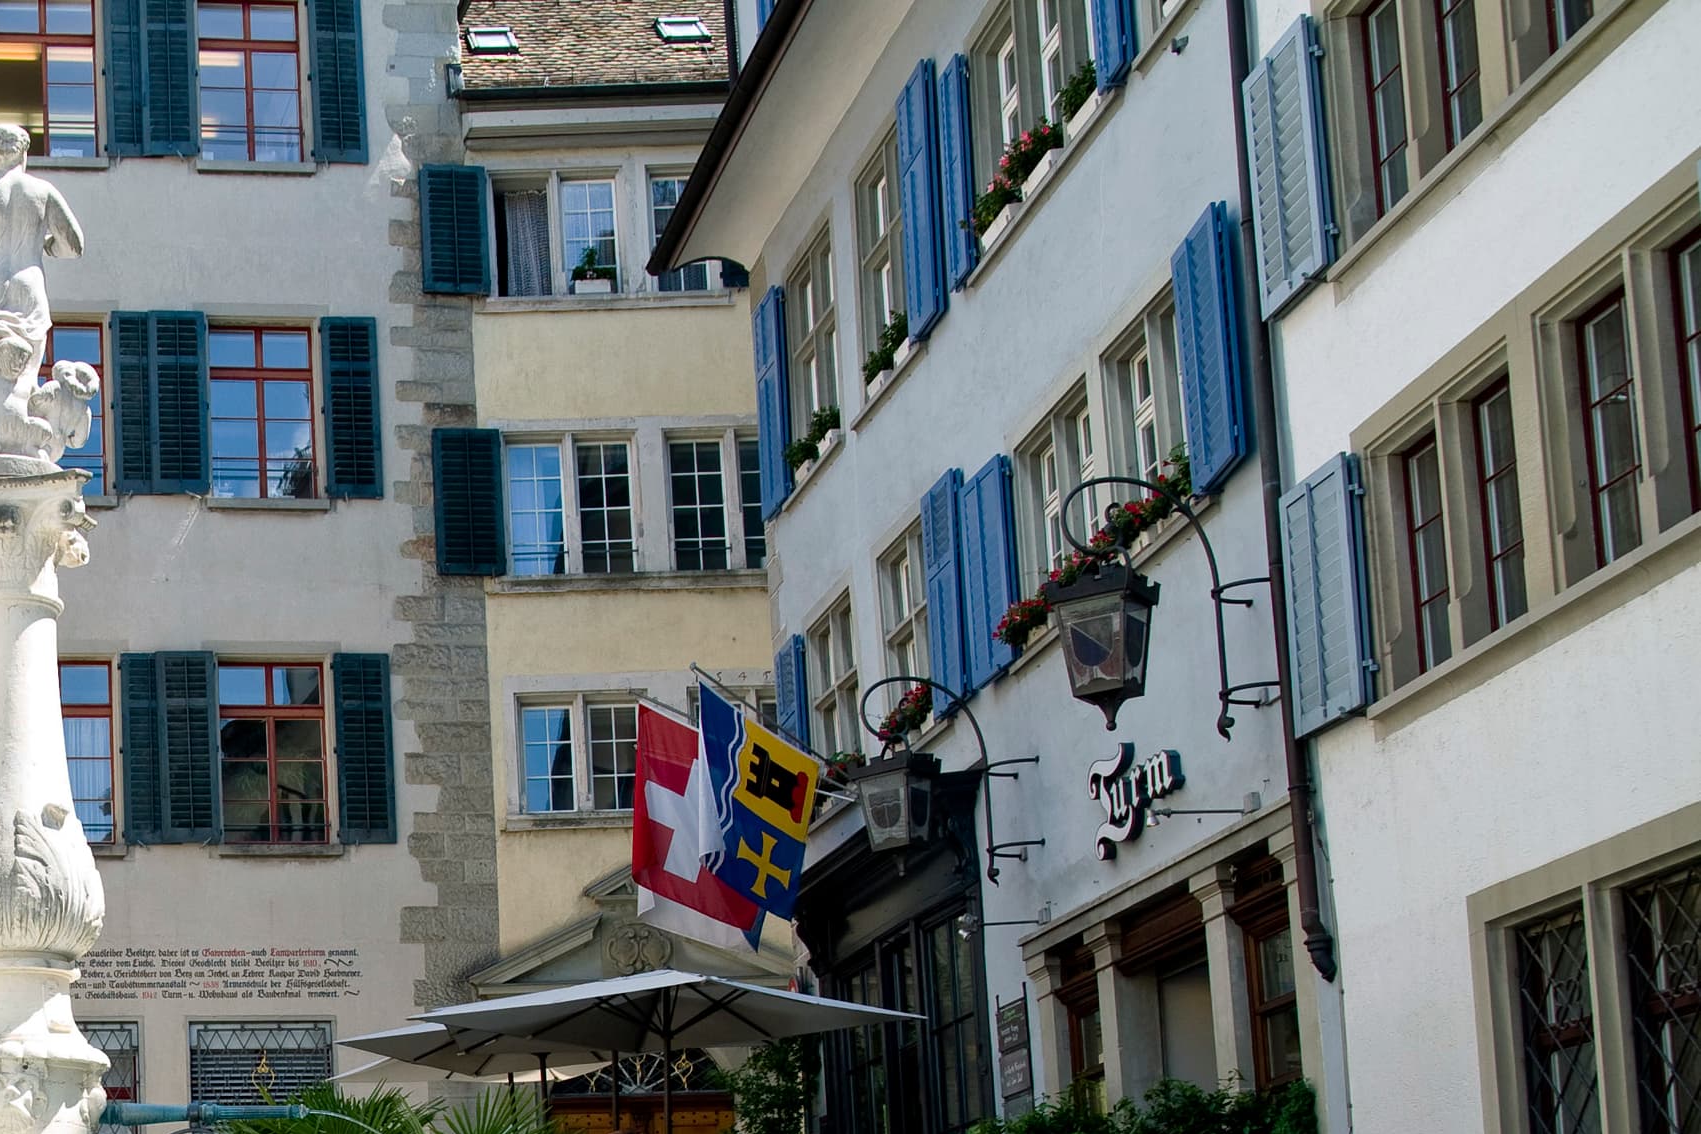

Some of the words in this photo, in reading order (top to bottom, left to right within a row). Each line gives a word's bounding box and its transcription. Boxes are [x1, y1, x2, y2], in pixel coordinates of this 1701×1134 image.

[1087, 741, 1186, 861] Turm
[158, 948, 178, 957] daher
[116, 959, 131, 968] vom
[230, 958, 251, 968] bleibt
[255, 958, 285, 968] Besitzer
[288, 958, 299, 968] bis
[159, 969, 172, 978] von
[194, 969, 205, 978] am
[231, 969, 240, 978] an
[241, 969, 265, 978] Lehrer
[297, 969, 321, 978] David
[270, 979, 282, 989] der
[198, 989, 238, 999] Wohnhaus
[241, 989, 253, 999] als
[257, 989, 301, 999] Baudenkmal
